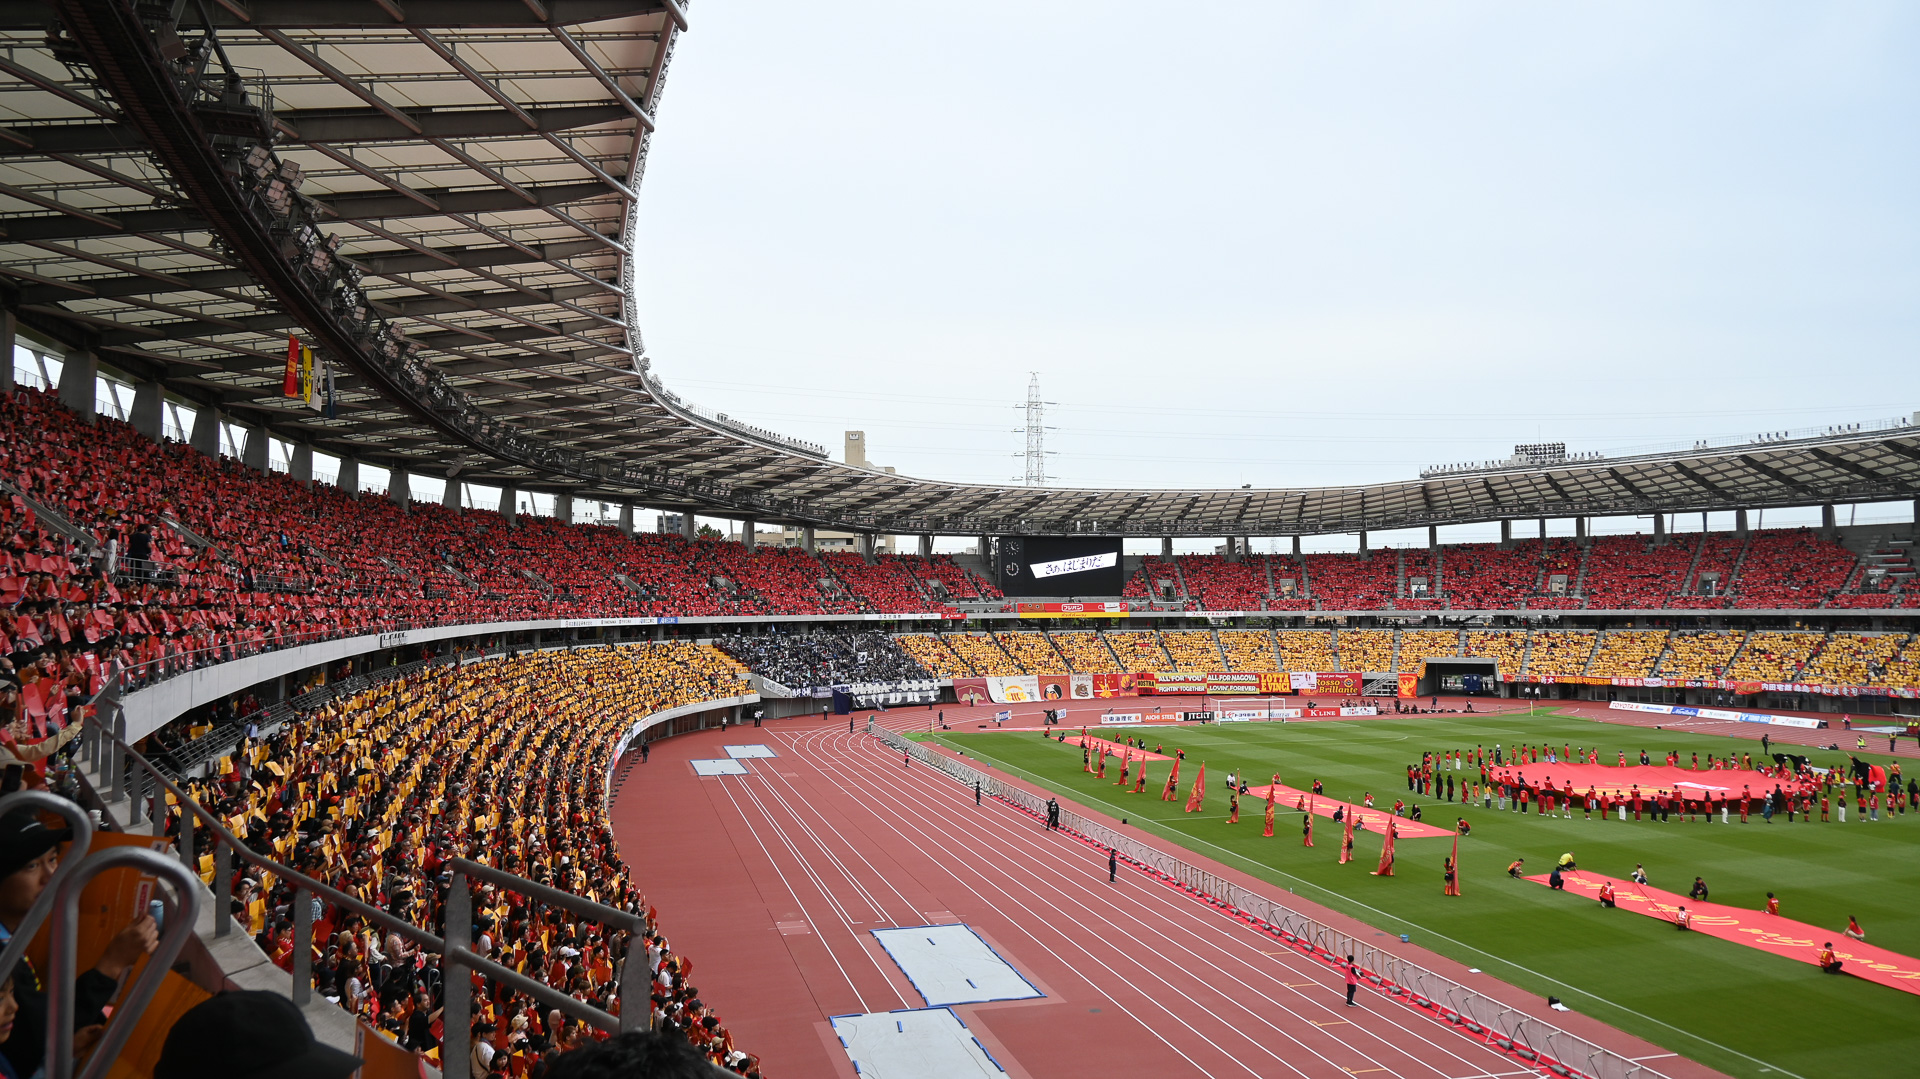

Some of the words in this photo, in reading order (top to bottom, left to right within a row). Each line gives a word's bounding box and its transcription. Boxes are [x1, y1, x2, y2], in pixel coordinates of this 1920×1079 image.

[1261, 673, 1289, 683] LOTTA
[1267, 683, 1290, 692] VINCI
[1319, 686, 1358, 694] Brillante
[1611, 702, 1634, 710] TOYOTA
[1145, 713, 1160, 721] AICHI
[1161, 712, 1175, 720] STEEL
